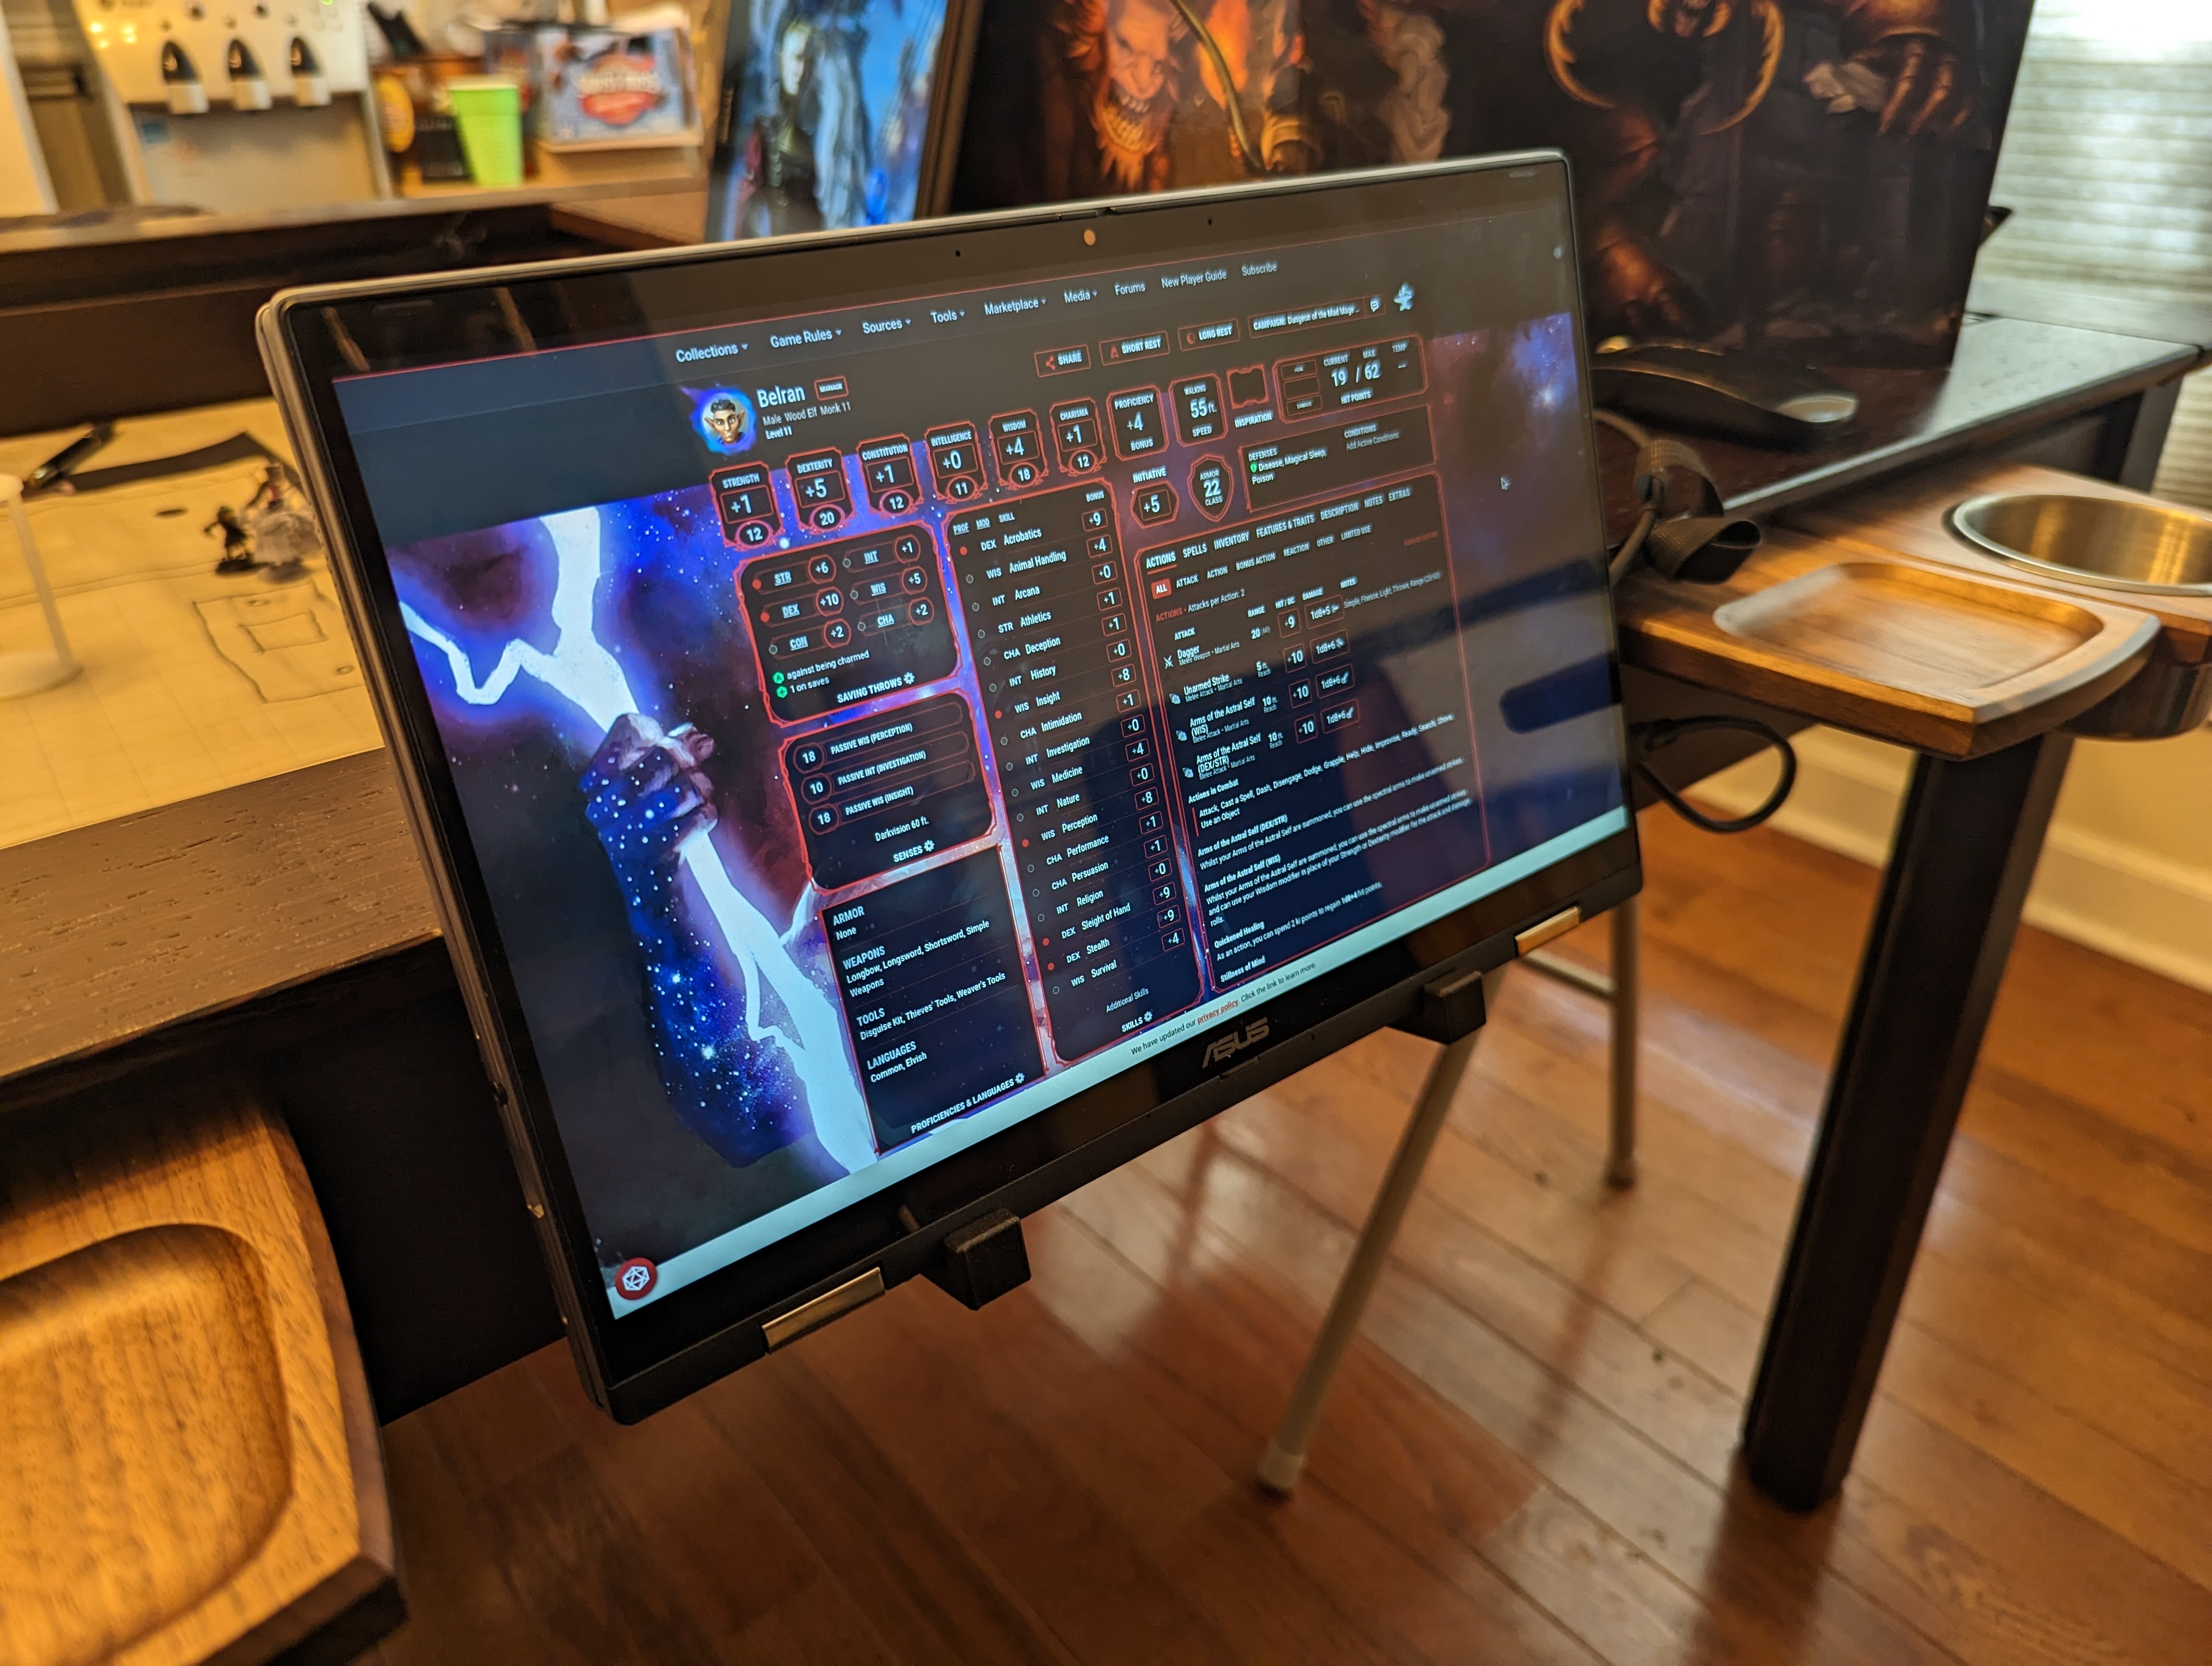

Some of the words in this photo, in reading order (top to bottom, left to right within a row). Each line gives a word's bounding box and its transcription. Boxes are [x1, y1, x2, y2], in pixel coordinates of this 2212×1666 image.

[675, 343, 739, 363] Collections
[769, 334, 803, 349] Game
[802, 329, 833, 344] Rules
[861, 319, 903, 335] Sources
[930, 309, 958, 324] Tools
[983, 298, 1039, 316] Marketplace
[1063, 290, 1091, 304] Media
[1114, 282, 1146, 296] Forums
[1160, 277, 1180, 289] New
[1179, 273, 1205, 287] Player
[1204, 269, 1227, 283] Guide
[1240, 261, 1278, 277] Subscribe
[1198, 327, 1216, 341] LONG
[1215, 324, 1233, 338] REST
[1121, 339, 1144, 355] SHORT
[1143, 335, 1162, 350] REST
[1057, 350, 1083, 366] SHARE
[1330, 368, 1348, 387] 19
[1355, 366, 1361, 383] /
[1364, 361, 1381, 381] 62
[756, 385, 806, 408] Belran
[1183, 383, 1207, 396] WALKING
[1340, 393, 1352, 405] HIT
[1349, 388, 1372, 402] POINTS
[1114, 393, 1154, 411] PROFICIENCY
[1189, 397, 1208, 419] 55
[762, 414, 782, 426] Male
[783, 408, 807, 422] Wood
[806, 406, 818, 419] Elf
[819, 402, 842, 416] Monk
[841, 401, 852, 412] 11
[1059, 407, 1089, 421] CHARISMA
[1127, 411, 1144, 431] +4
[764, 427, 785, 440] Level
[783, 425, 793, 437] 11
[1001, 419, 1027, 433] WISDOM
[1065, 424, 1082, 444] +1
[1192, 424, 1213, 438] SPEED
[930, 429, 973, 447] INTELLIGENCE
[1005, 436, 1025, 456] +4
[1130, 437, 1154, 452] BONUS
[861, 443, 909, 462] CONSTITUTION
[942, 450, 962, 470] +0
[796, 458, 833, 475] DEXTERITY
[876, 464, 895, 484] +1
[1132, 465, 1167, 484] INITIATIVE
[1199, 469, 1220, 481] ARMOR
[722, 472, 761, 489] STRENGTH
[805, 477, 827, 498] +5
[1203, 477, 1221, 498] 22
[730, 494, 752, 514] +1
[1143, 494, 1161, 514] +5
[1204, 495, 1224, 507] CLASS
[998, 511, 1016, 523] SKILL
[1003, 528, 1043, 546] Acrobatics
[1146, 550, 1177, 569] ACTIONS
[1182, 542, 1208, 559] SPELLS
[1213, 531, 1250, 550] INVENTORY
[1255, 521, 1288, 539] FEATURES
[1287, 520, 1293, 530] &
[1291, 513, 1315, 528] TRAITS
[774, 571, 793, 587] STR
[815, 561, 829, 574] +6
[863, 550, 879, 565] INT
[901, 541, 914, 554] +1
[1008, 557, 1035, 574] Animal
[1033, 550, 1067, 567] Handling
[1155, 583, 1168, 594] ALL
[1175, 574, 1199, 589] ATTACK
[1206, 565, 1229, 580] ACTION
[1235, 558, 1256, 572] BONUS
[1255, 552, 1276, 566] ACTION
[781, 603, 801, 619] DEX
[820, 592, 840, 607] +10
[870, 582, 888, 597] WIS
[908, 572, 922, 585] +5
[1014, 585, 1041, 601] Arcana
[1187, 599, 1210, 613] Attacks
[1210, 597, 1220, 608] per
[1220, 591, 1240, 604] Action:
[1239, 588, 1246, 598] 2
[789, 635, 809, 652] CON
[830, 625, 845, 638] +2
[876, 613, 895, 629] CHA
[915, 603, 929, 616] +2
[1020, 611, 1052, 628] Athletics
[1024, 637, 1062, 655] Deception
[1176, 645, 1200, 660] Dagger
[786, 665, 816, 681] against
[814, 659, 838, 672] being
[836, 649, 870, 667] charmed
[1030, 665, 1057, 681] History
[836, 686, 869, 704] SAVING
[867, 676, 903, 695] THROWS
[1183, 677, 1212, 696] Unarmed
[1211, 673, 1230, 687] Strike
[1035, 690, 1061, 707] Insight
[1040, 712, 1083, 733] Intimidation
[801, 750, 816, 764] 18
[829, 739, 858, 755] PASSIVE
[856, 735, 871, 747] WIS
[870, 722, 914, 745] (PERCEPTION)
[1045, 736, 1091, 759] Investigation
[1051, 766, 1083, 784] Medicine
[1056, 793, 1081, 809] Nature
[1188, 790, 1211, 805] Actions
[1209, 786, 1217, 796] in
[1216, 778, 1239, 793] Combat
[874, 823, 911, 842] Darkvision
[910, 818, 921, 829] 60
[919, 815, 930, 826] ft.
[1061, 813, 1098, 834] Perception
[892, 844, 924, 863] SENSES
[1066, 835, 1110, 858] Performance
[1071, 861, 1109, 883] Persuasion
[1076, 890, 1104, 907] Religion
[833, 905, 865, 927] ARMOR
[1081, 913, 1105, 931] Sleight
[1104, 909, 1113, 921] of
[1113, 901, 1131, 918] Hand
[835, 926, 857, 941] None
[1213, 928, 1244, 949] Quickened
[1242, 920, 1265, 936] Healing
[845, 964, 883, 984] Longbow,
[882, 945, 925, 970] Longsword,
[923, 928, 967, 953] Shortsword,
[965, 919, 990, 935] Simple
[1085, 937, 1110, 955] Stealth
[842, 945, 886, 970] WEAPONS
[1090, 959, 1117, 978] Survival
[1219, 966, 1245, 983] Stillness
[1244, 961, 1252, 972] of
[1250, 954, 1266, 969] Mind
[848, 978, 885, 998] Weapons
[1105, 992, 1134, 1014] Additional
[1133, 987, 1149, 1001] Skills
[1130, 1045, 1142, 1056] We
[1142, 1037, 1159, 1050] have
[1159, 1022, 1186, 1043] updated
[1185, 1018, 1197, 1029] our
[1197, 1008, 1221, 1026] privacy
[1220, 999, 1239, 1015] policy.
[1240, 990, 1257, 1003] Click
[1255, 985, 1266, 996] the
[1265, 979, 1278, 991] link
[1277, 977, 1285, 985] to
[1284, 970, 1300, 982] learn
[1299, 962, 1317, 975] more.
[856, 1007, 886, 1027] TOOLS
[1121, 1016, 1144, 1033] SKILLS
[1201, 1016, 1270, 1069] ASUS
[866, 1040, 917, 1071] LANGUAGES
[870, 1063, 906, 1083] Common,
[904, 1051, 928, 1068] Elvish
[910, 1101, 966, 1135] PROFICIENCIES
[965, 1098, 973, 1108] &
[972, 1078, 1015, 1105] LANGUAGES
